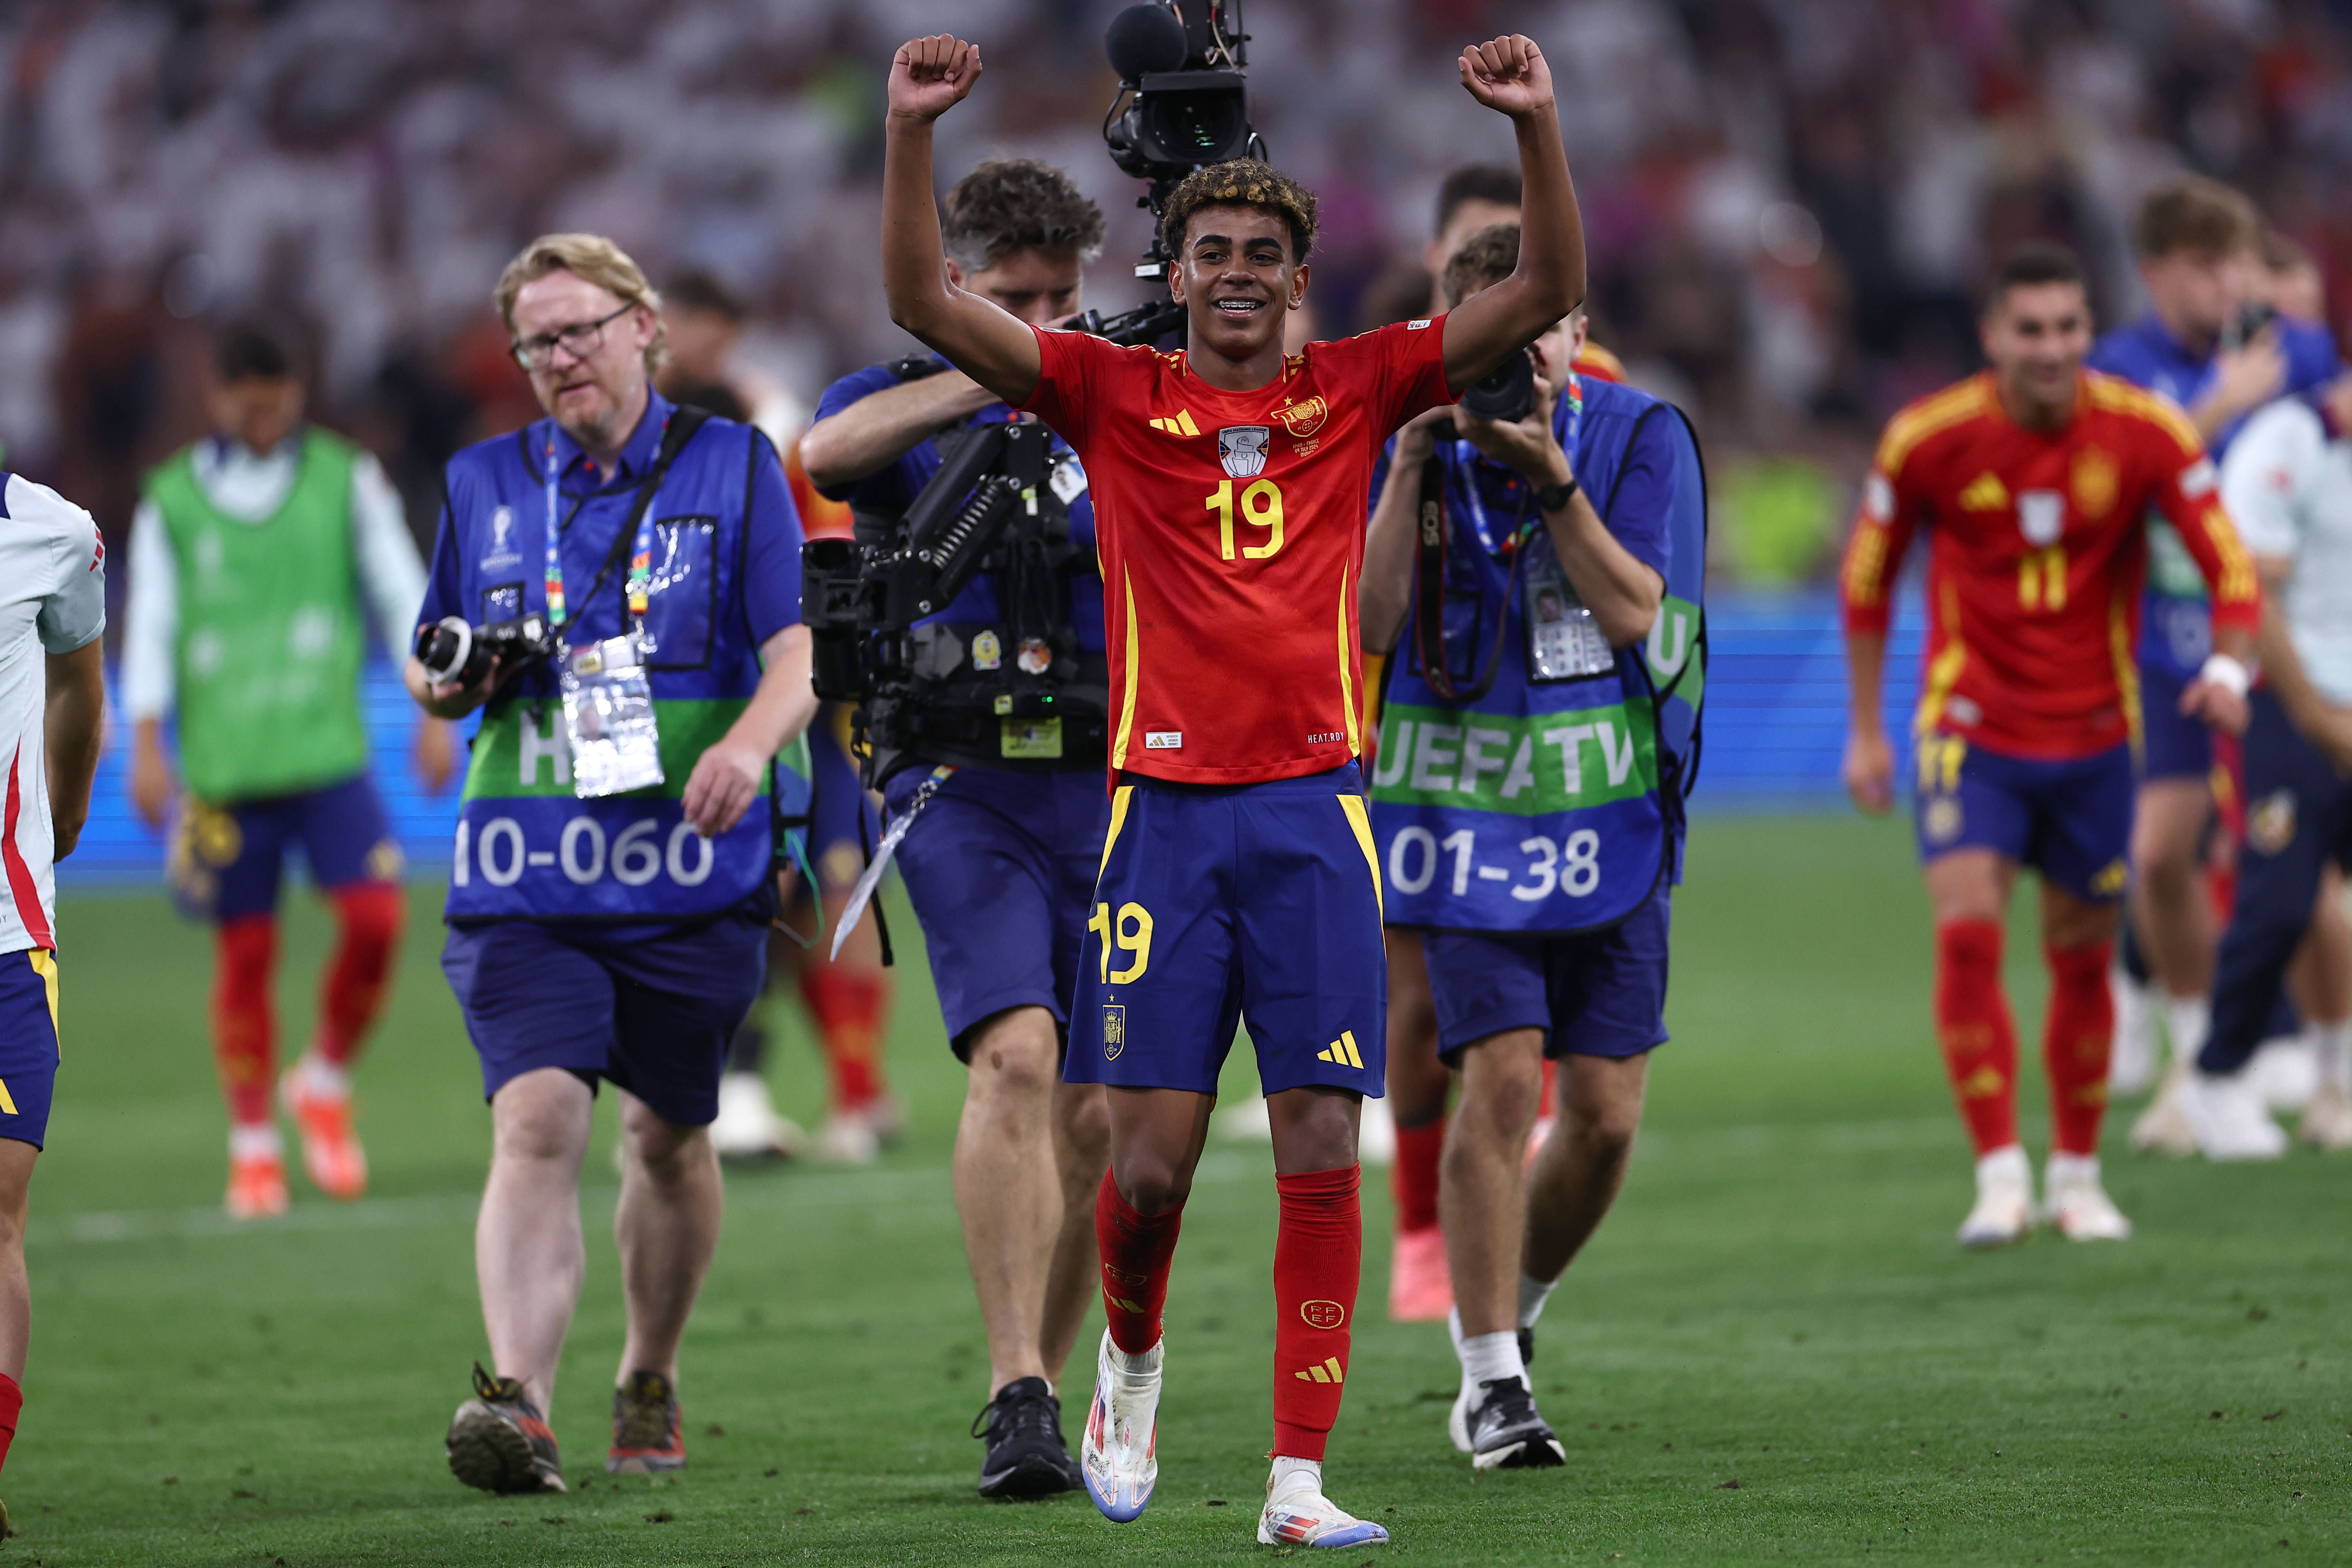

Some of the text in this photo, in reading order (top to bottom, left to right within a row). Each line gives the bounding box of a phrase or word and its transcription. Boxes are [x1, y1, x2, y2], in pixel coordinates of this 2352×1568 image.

[1205, 479, 1284, 560] 19
[1308, 732, 1343, 744] HEAT.RDY
[1389, 825, 1600, 901] 01-38
[1088, 902, 1154, 984] 19
